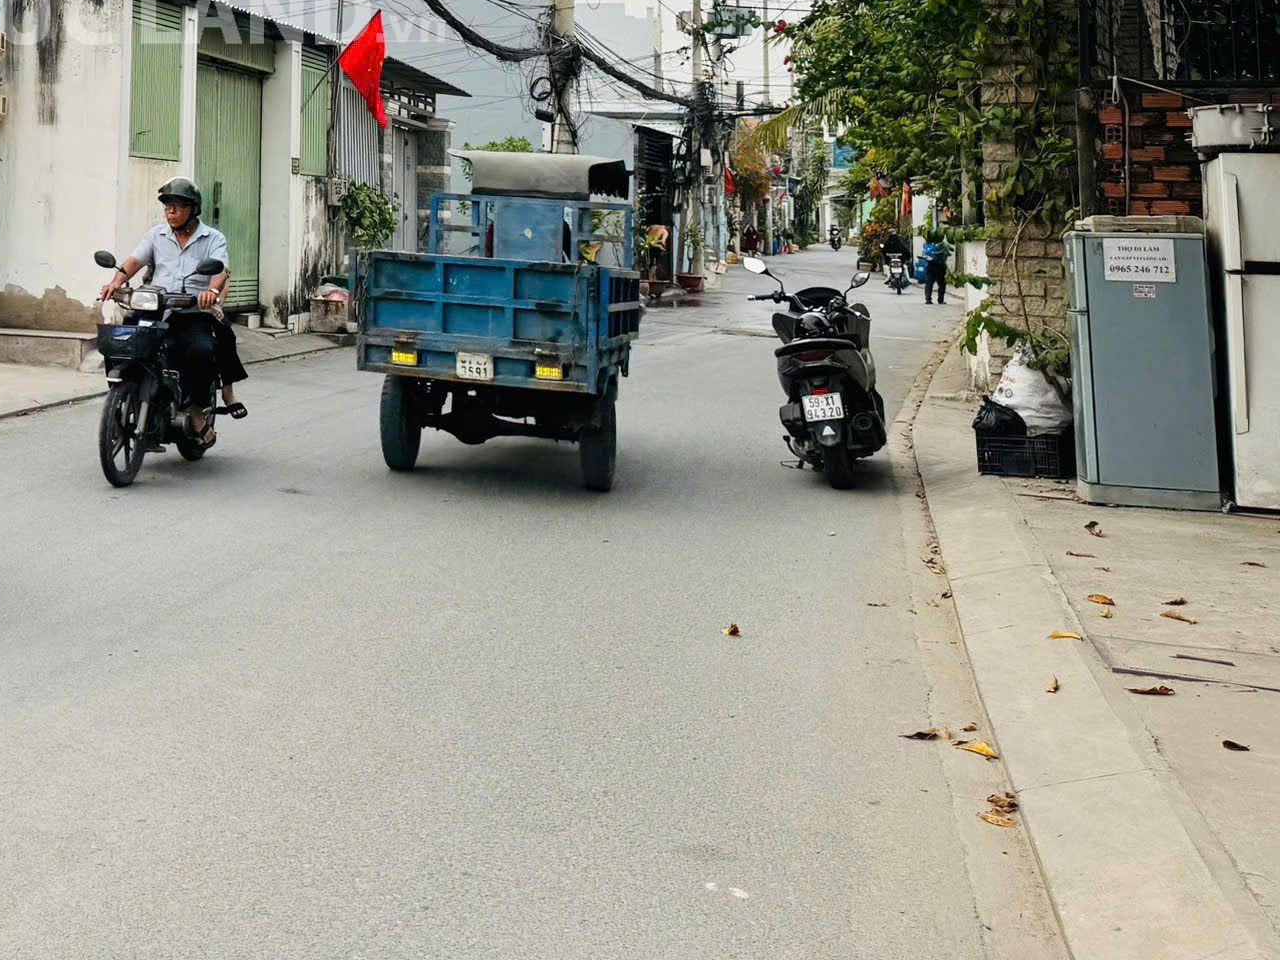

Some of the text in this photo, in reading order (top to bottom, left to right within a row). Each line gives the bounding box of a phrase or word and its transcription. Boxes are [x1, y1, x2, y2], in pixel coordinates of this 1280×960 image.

[1110, 265, 1170, 274] 0965 246 712
